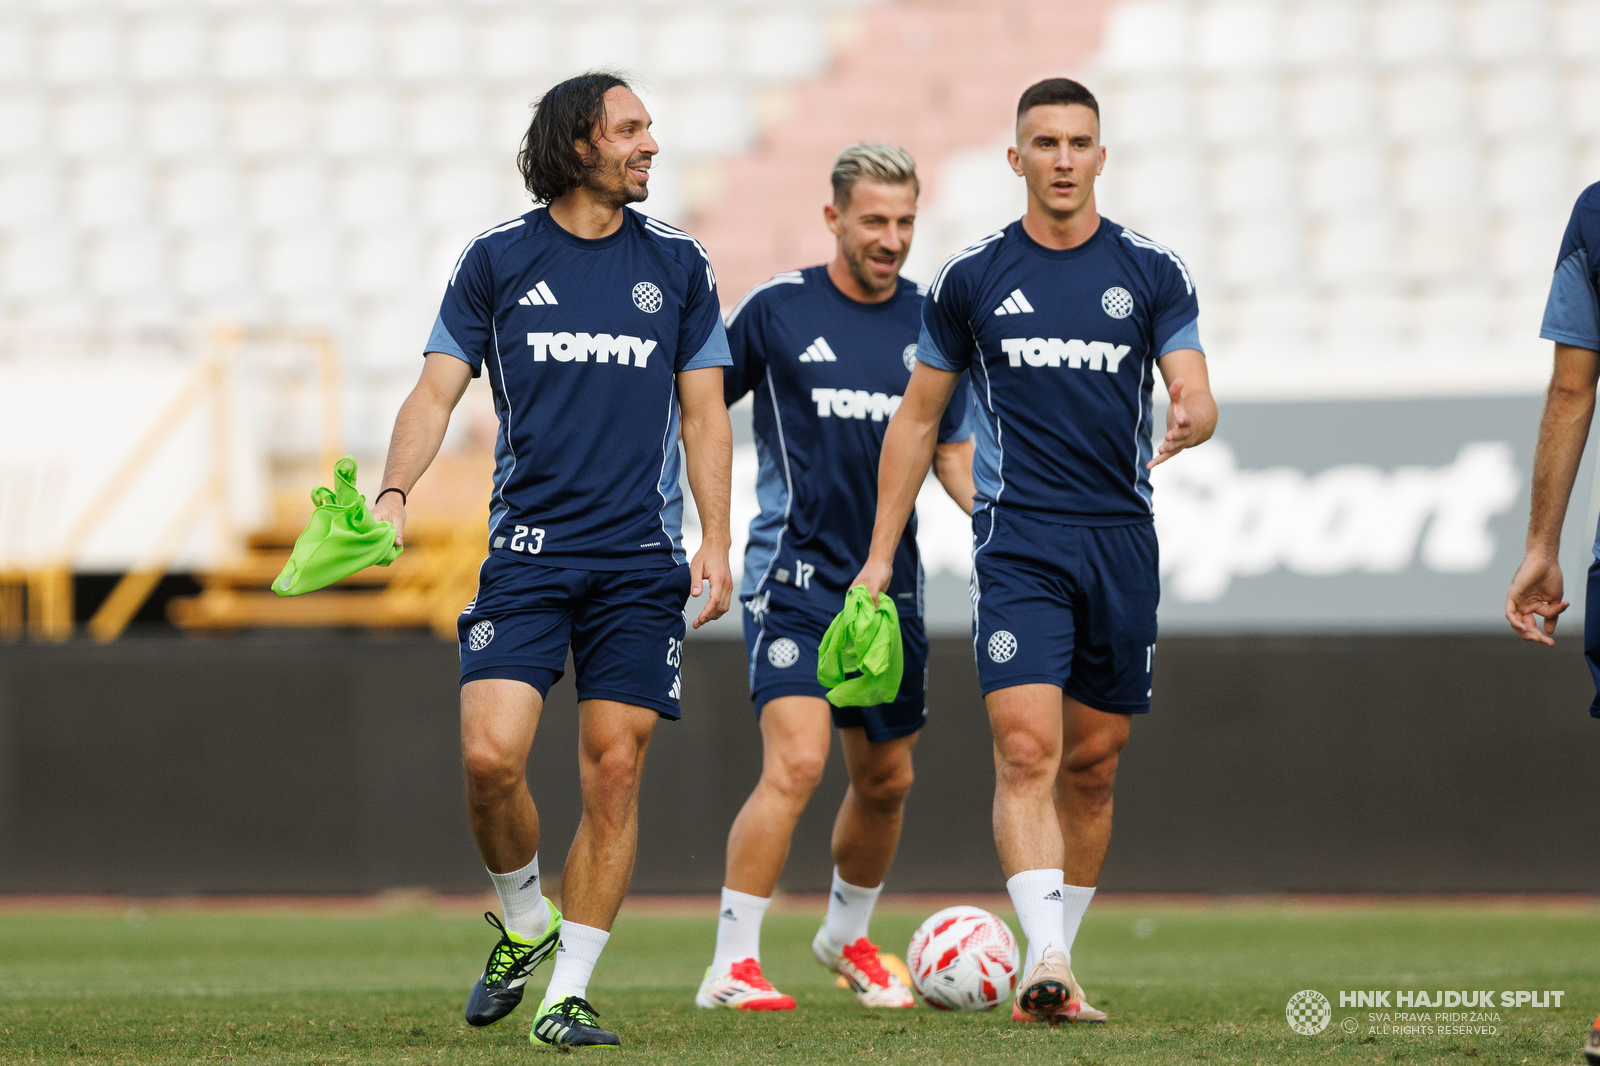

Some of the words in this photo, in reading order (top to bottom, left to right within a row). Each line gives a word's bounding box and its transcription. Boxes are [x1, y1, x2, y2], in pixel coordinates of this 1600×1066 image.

[526, 331, 658, 369] TOMMY
[1000, 337, 1131, 374] TOMMY
[811, 387, 904, 422] TOMM
[511, 524, 546, 555] 23
[795, 559, 815, 590] 17
